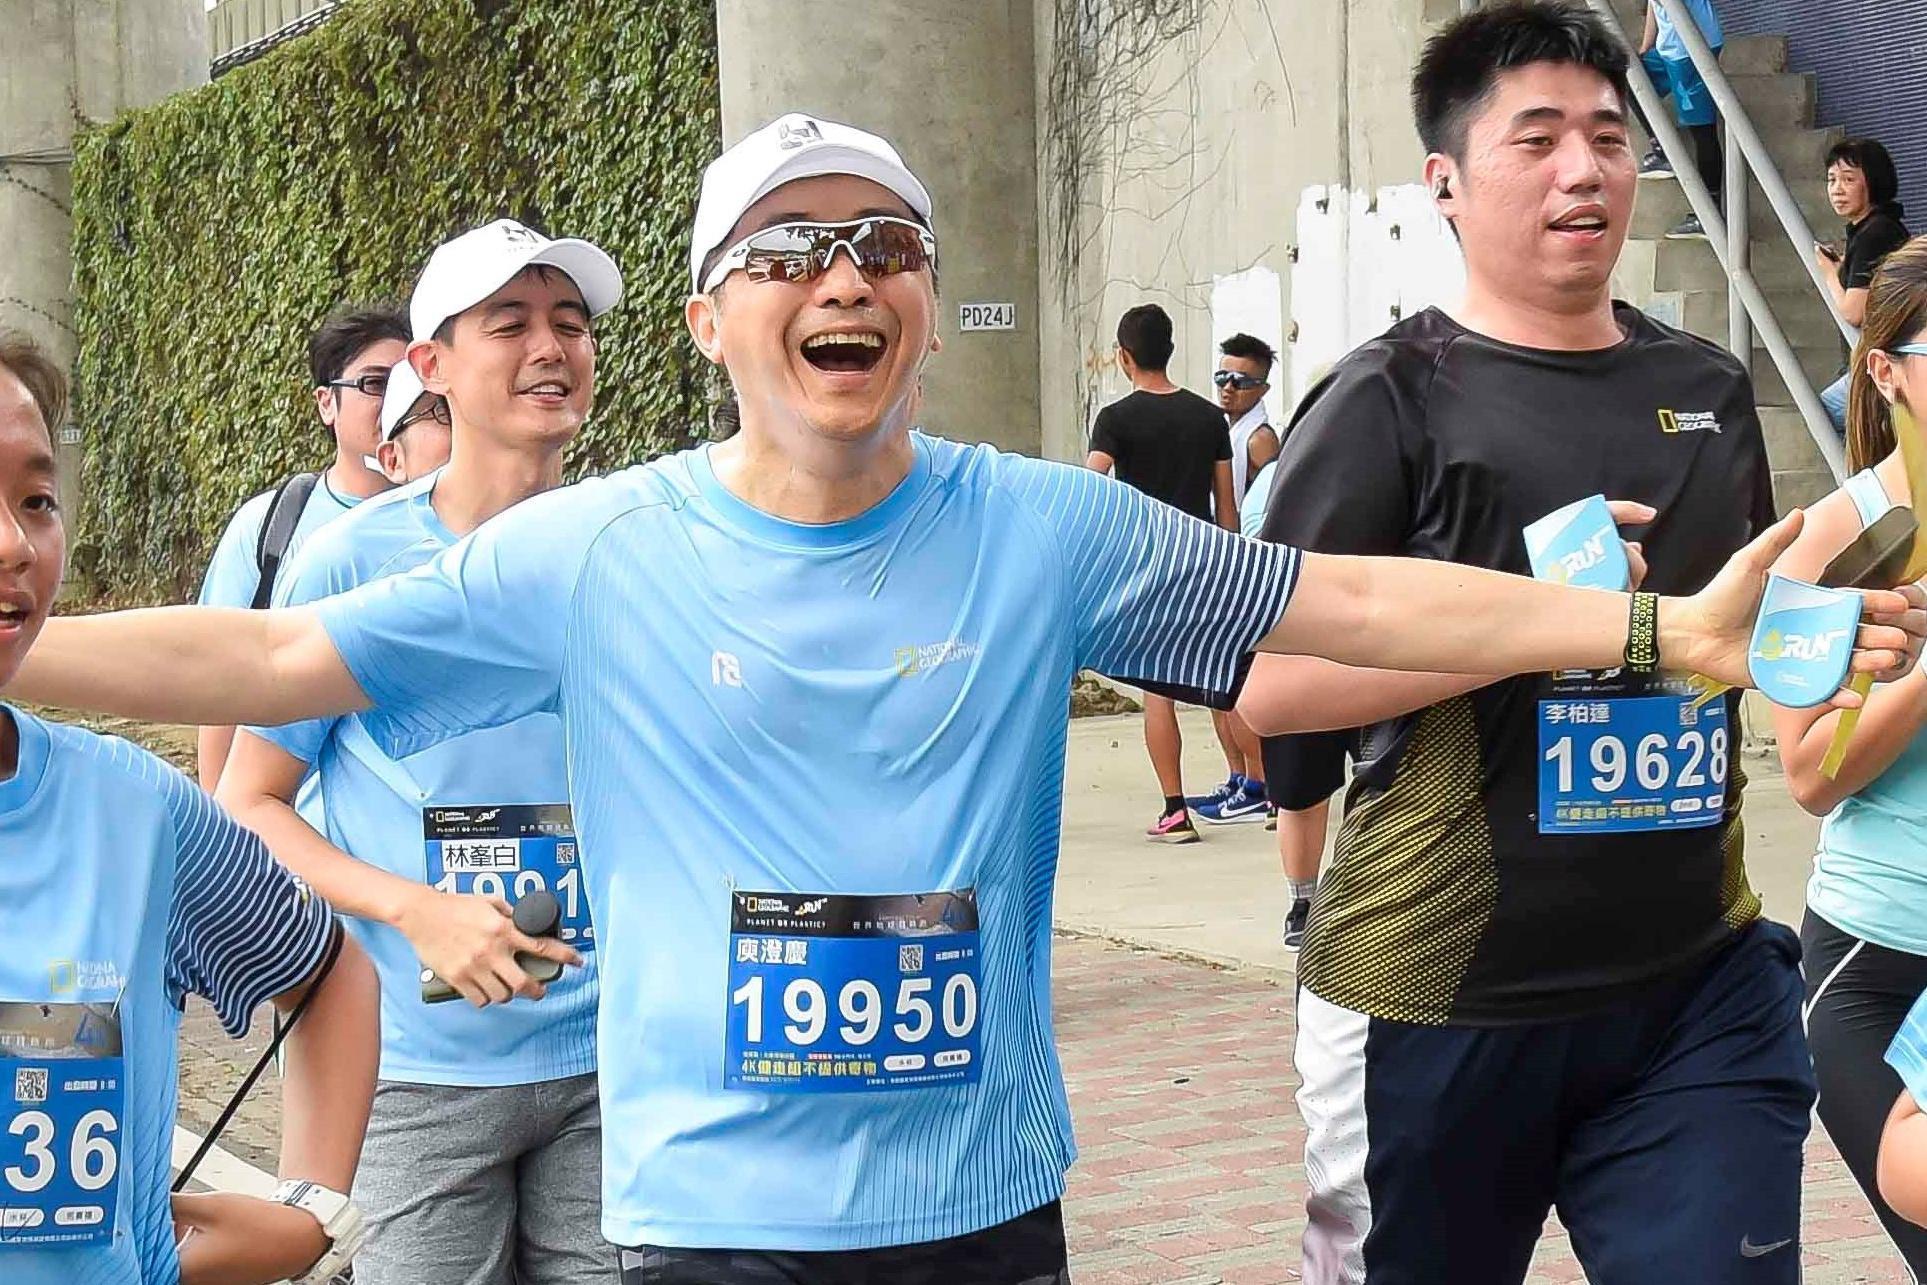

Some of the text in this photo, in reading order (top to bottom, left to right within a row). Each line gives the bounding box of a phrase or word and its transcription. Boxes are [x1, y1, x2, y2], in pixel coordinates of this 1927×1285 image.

[962, 306, 1013, 327] PD24J
[1783, 630, 1838, 662] RUN
[1545, 727, 1728, 793] 19628
[445, 844, 517, 868] 林峯白
[732, 973, 977, 1046] 19950
